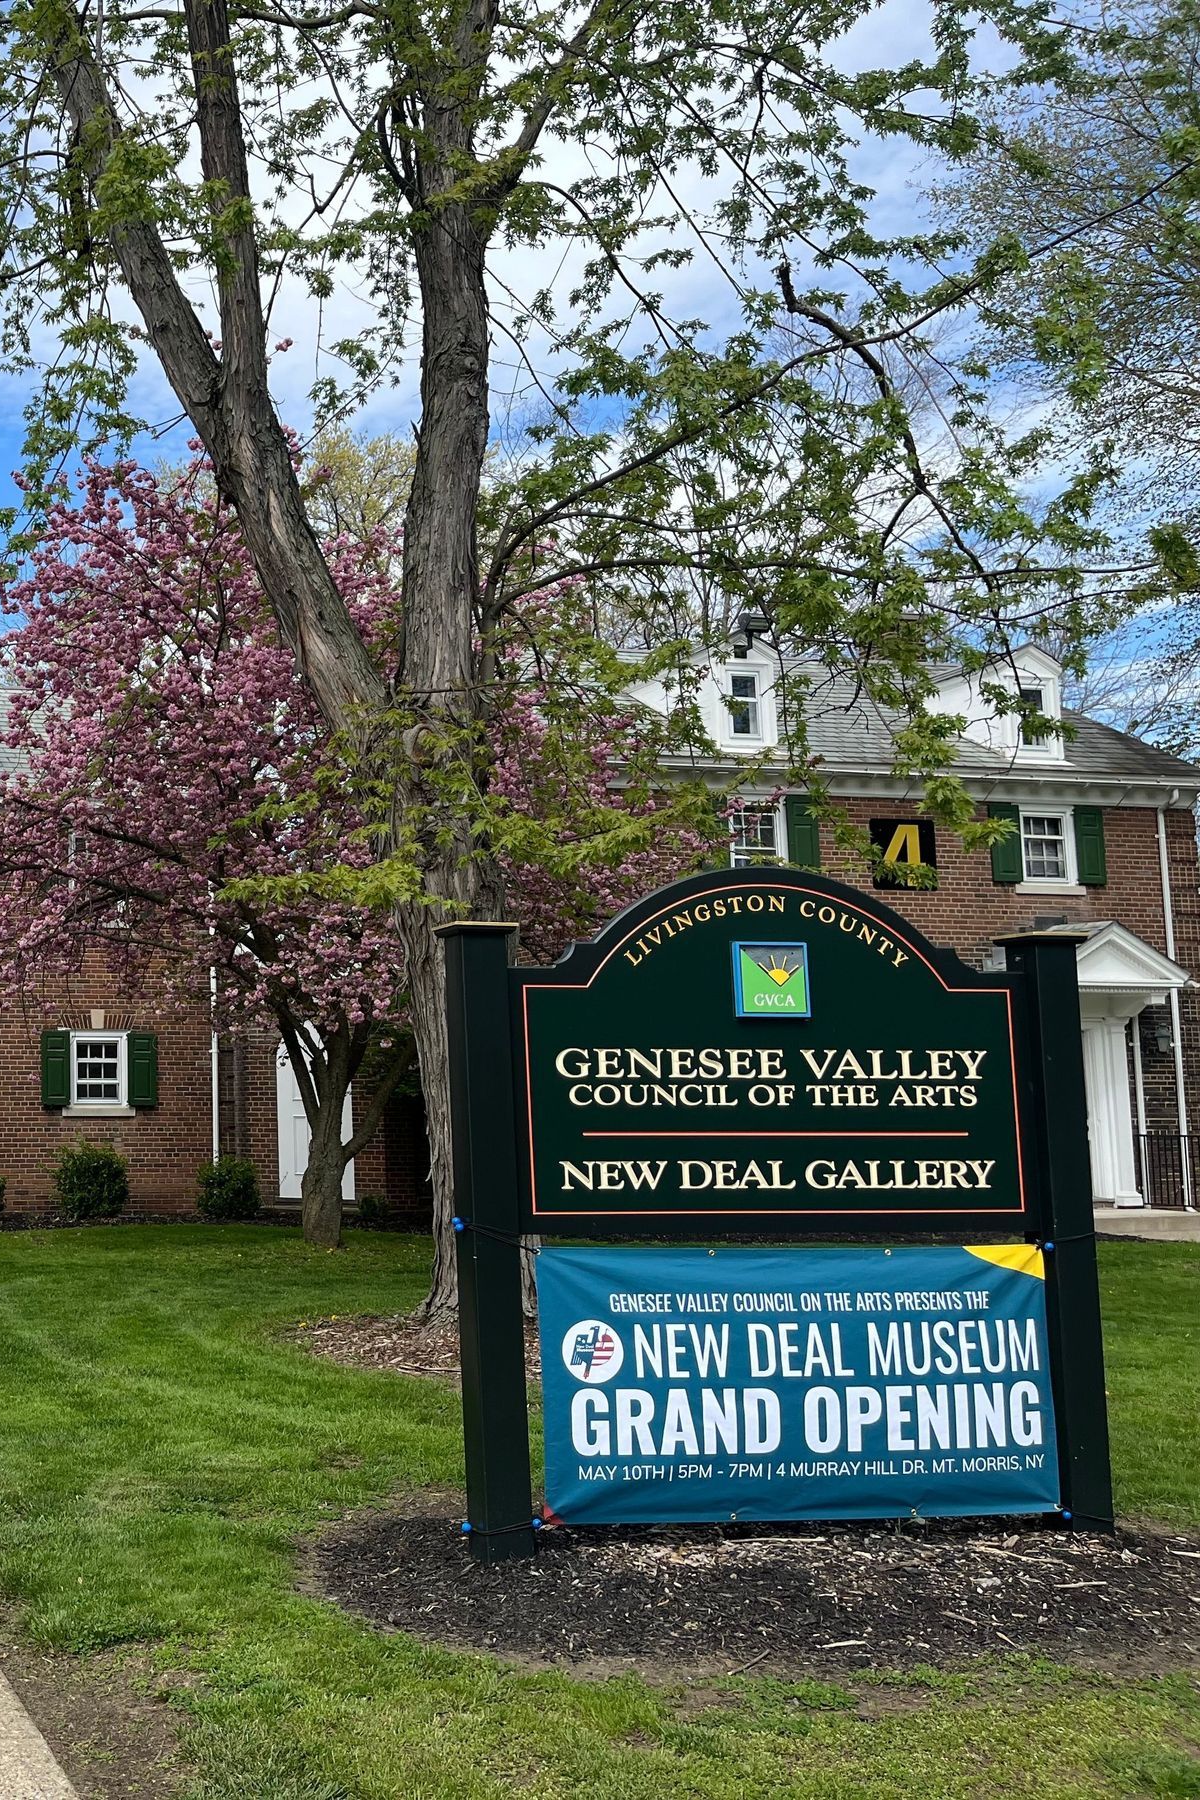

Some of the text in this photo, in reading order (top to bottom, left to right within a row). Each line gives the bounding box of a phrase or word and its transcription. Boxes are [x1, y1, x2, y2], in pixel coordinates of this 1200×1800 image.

[623, 895, 911, 968] LIVINGSTON COUNTY
[754, 993, 796, 1007] GVCA
[555, 1047, 988, 1081] GENESEE VALLEY
[568, 1084, 978, 1107] COUNCIL OF THE ARTS
[558, 1159, 996, 1190] NEW DEAL GALLERY
[609, 1290, 990, 1313] GENESEE VALLEY COUNCIL ON THE ARTS PRESENTS THE
[633, 1318, 1041, 1379] NEW DEAL MUSEUM
[570, 1380, 1044, 1457] GRAND OPENING
[578, 1466, 617, 1480] MAY
[622, 1465, 665, 1480] 10TH
[678, 1464, 713, 1479] 5PM
[729, 1463, 763, 1478] 7PM
[775, 1463, 786, 1478] 4
[790, 1461, 861, 1477] MURRAY
[864, 1460, 898, 1475] HILL
[902, 1459, 929, 1475] DR.
[932, 1458, 959, 1473] MT.
[962, 1455, 1023, 1472] MORRIS,
[1025, 1454, 1045, 1469] NY
